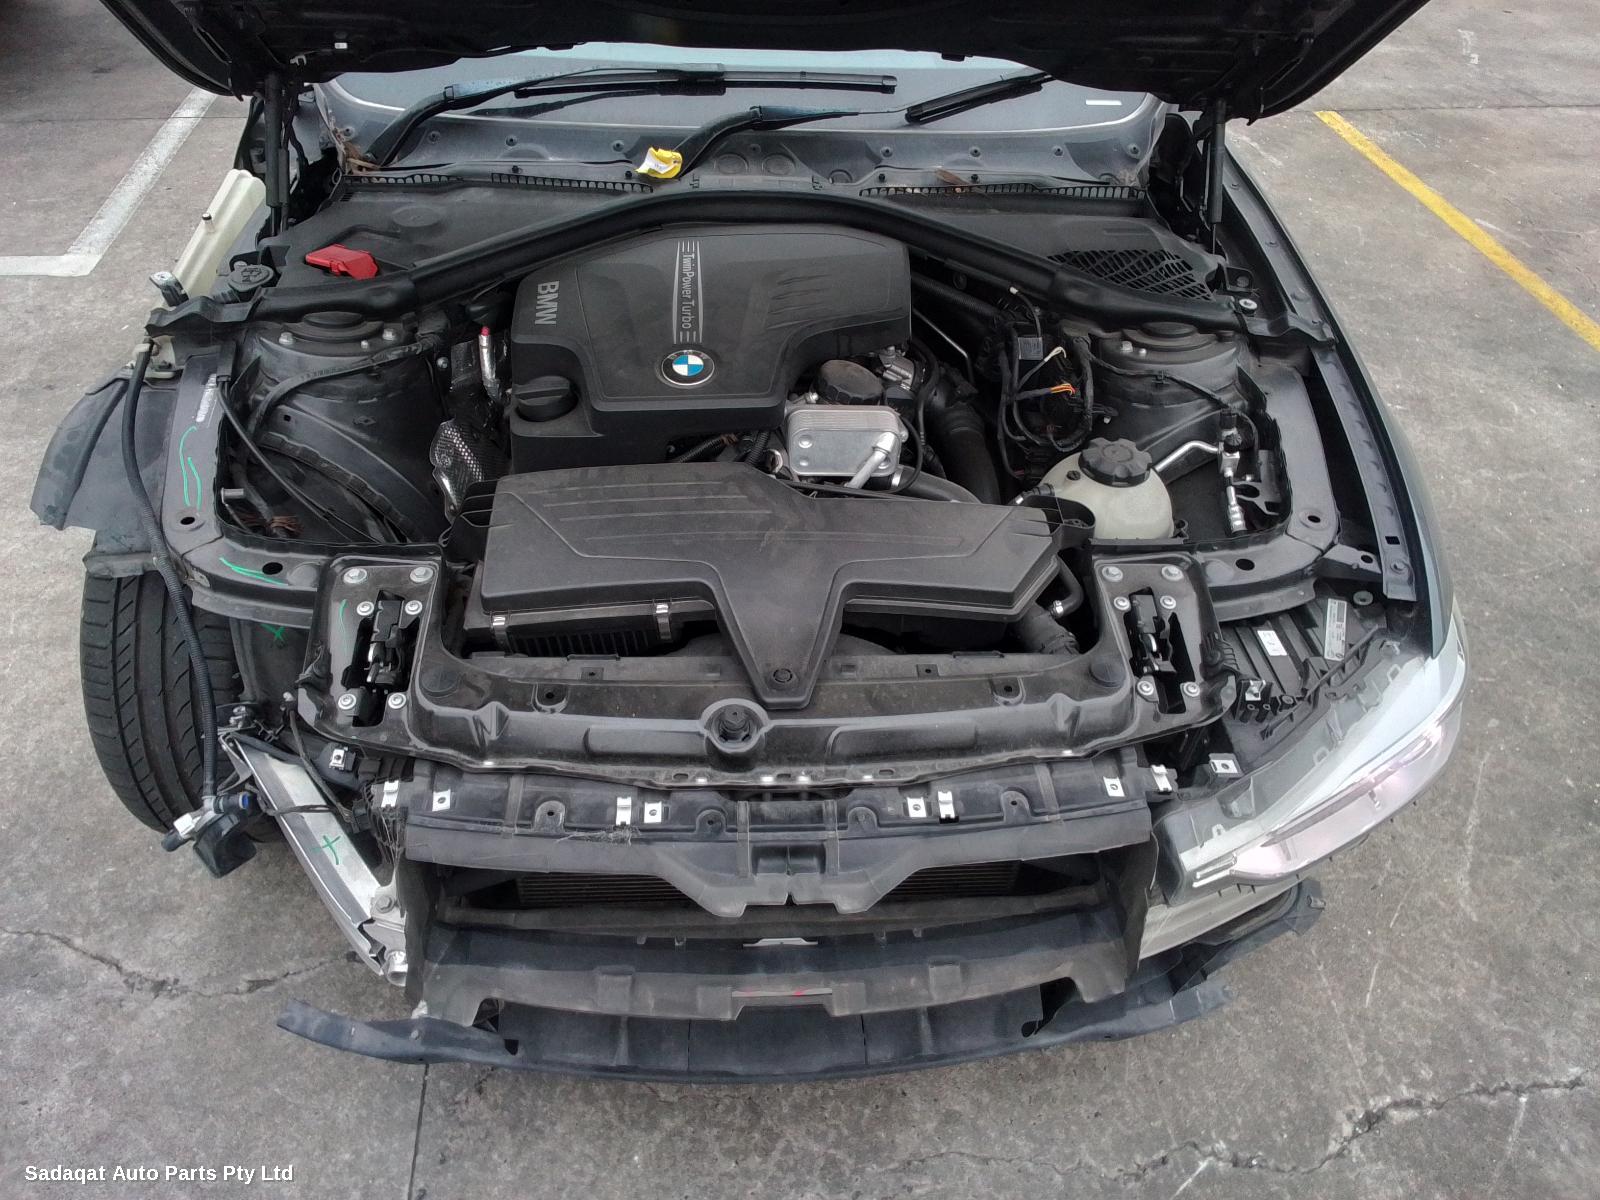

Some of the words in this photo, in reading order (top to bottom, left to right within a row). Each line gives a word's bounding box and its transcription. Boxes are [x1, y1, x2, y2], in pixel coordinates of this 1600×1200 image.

[682, 252, 695, 299] TwinPower
[535, 281, 560, 325] BMW
[682, 299, 695, 329] Turbo
